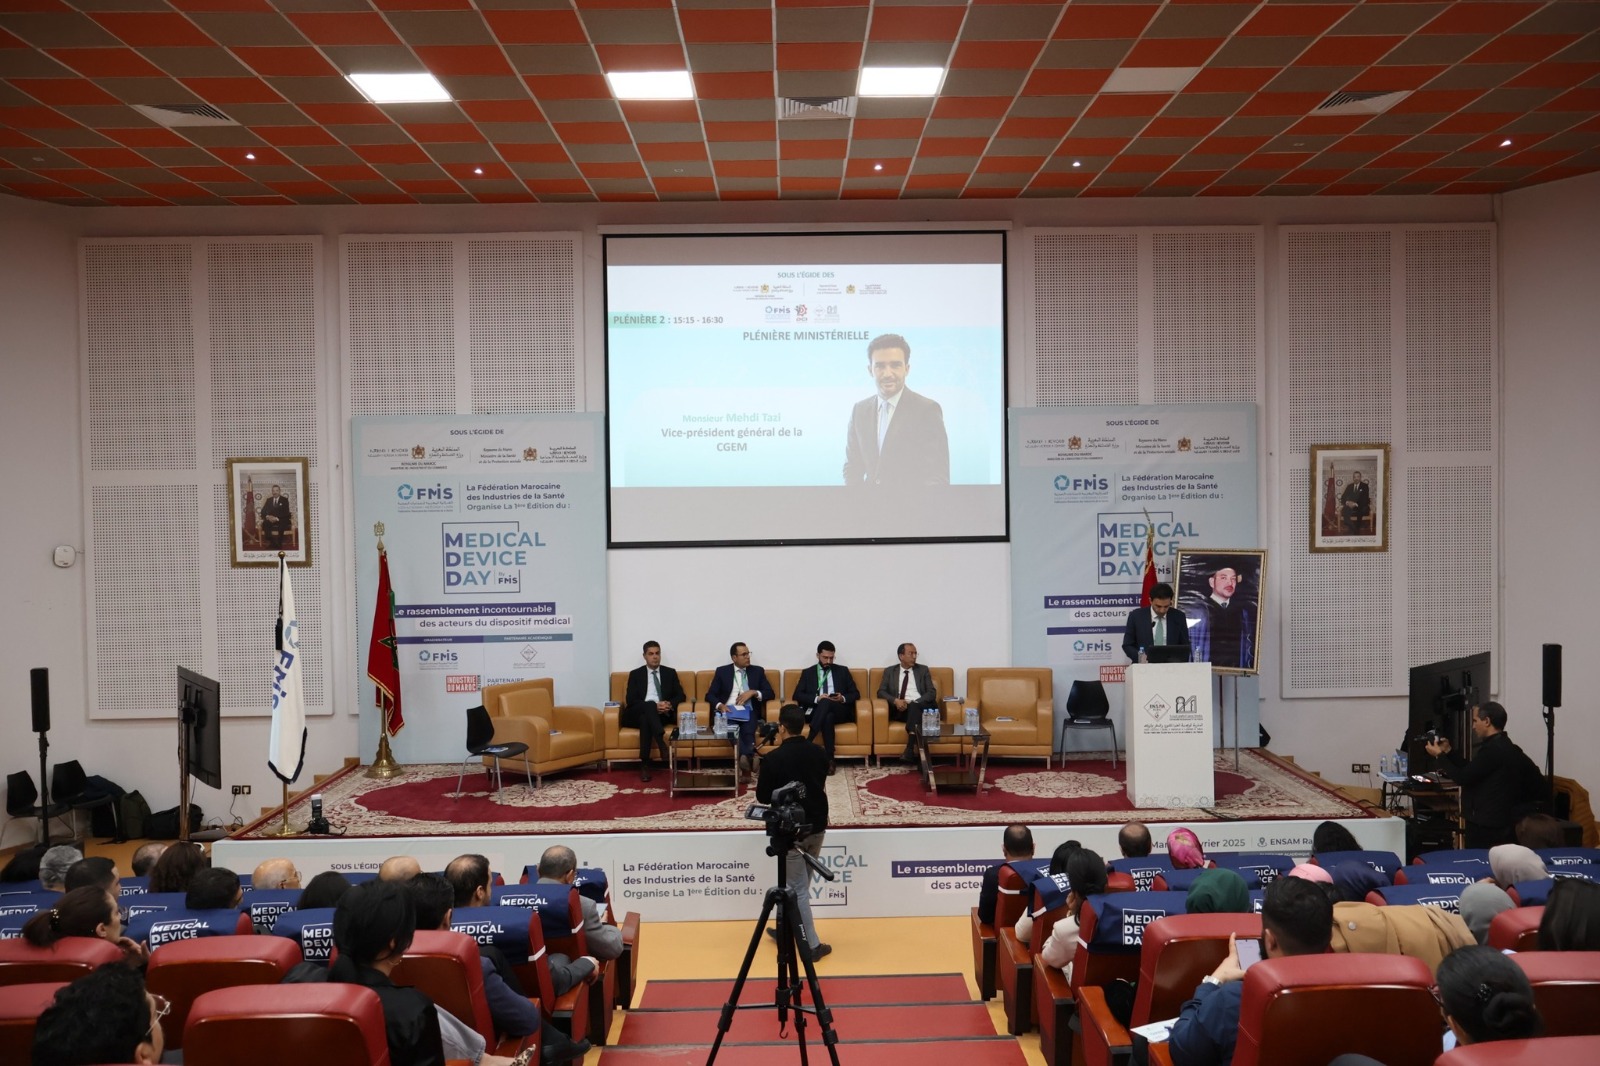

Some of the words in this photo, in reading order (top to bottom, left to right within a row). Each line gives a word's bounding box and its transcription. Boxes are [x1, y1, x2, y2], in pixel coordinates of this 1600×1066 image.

[613, 314, 657, 324] PLÉNIÈRE
[660, 316, 666, 324] 2
[702, 316, 723, 324] 16:30
[743, 330, 791, 340] PLÉNIÈRE
[794, 329, 869, 340] MINISTÉRIELLE
[682, 414, 723, 423] Monsieur
[726, 413, 759, 422] Mehdi
[762, 413, 781, 422] Tazi
[661, 428, 735, 439] Vice-président
[737, 428, 775, 438] général
[778, 428, 790, 436] de
[793, 428, 802, 436] la
[716, 443, 747, 452] CGEM
[467, 503, 501, 511] Organise
[445, 532, 546, 548] MEDICAL
[1100, 541, 1180, 557] DEVCE
[446, 551, 527, 566] DEVICE
[1101, 561, 1144, 576] DAY
[446, 570, 491, 587] DAY
[1048, 598, 1059, 606] Le
[1062, 597, 1133, 605] rassemblement
[407, 606, 479, 615] rassemblement
[482, 605, 552, 614] incontournable
[489, 618, 532, 628] dispositif
[534, 618, 570, 626] médical
[447, 676, 476, 684] INDUSTRIE
[1222, 839, 1246, 847] 2025
[638, 861, 693, 871] Fédération
[696, 860, 750, 870] Marocaine
[897, 865, 911, 874] Le
[623, 875, 641, 884] des
[644, 874, 695, 884] Industries
[698, 874, 712, 883] de
[714, 874, 722, 883] la
[726, 873, 755, 882] Santé
[931, 880, 951, 889] des
[623, 888, 669, 900] Organise
[672, 888, 684, 896] La
[687, 888, 702, 896] 1ère
[704, 887, 739, 896] Édition
[743, 887, 757, 895] du
[501, 898, 548, 906] MEDICAL
[152, 922, 209, 933] MEDICAL
[152, 930, 197, 943] DEVICE
[1125, 936, 1142, 945] DA
[304, 939, 333, 947] DEVI
[306, 948, 330, 956] DAY
